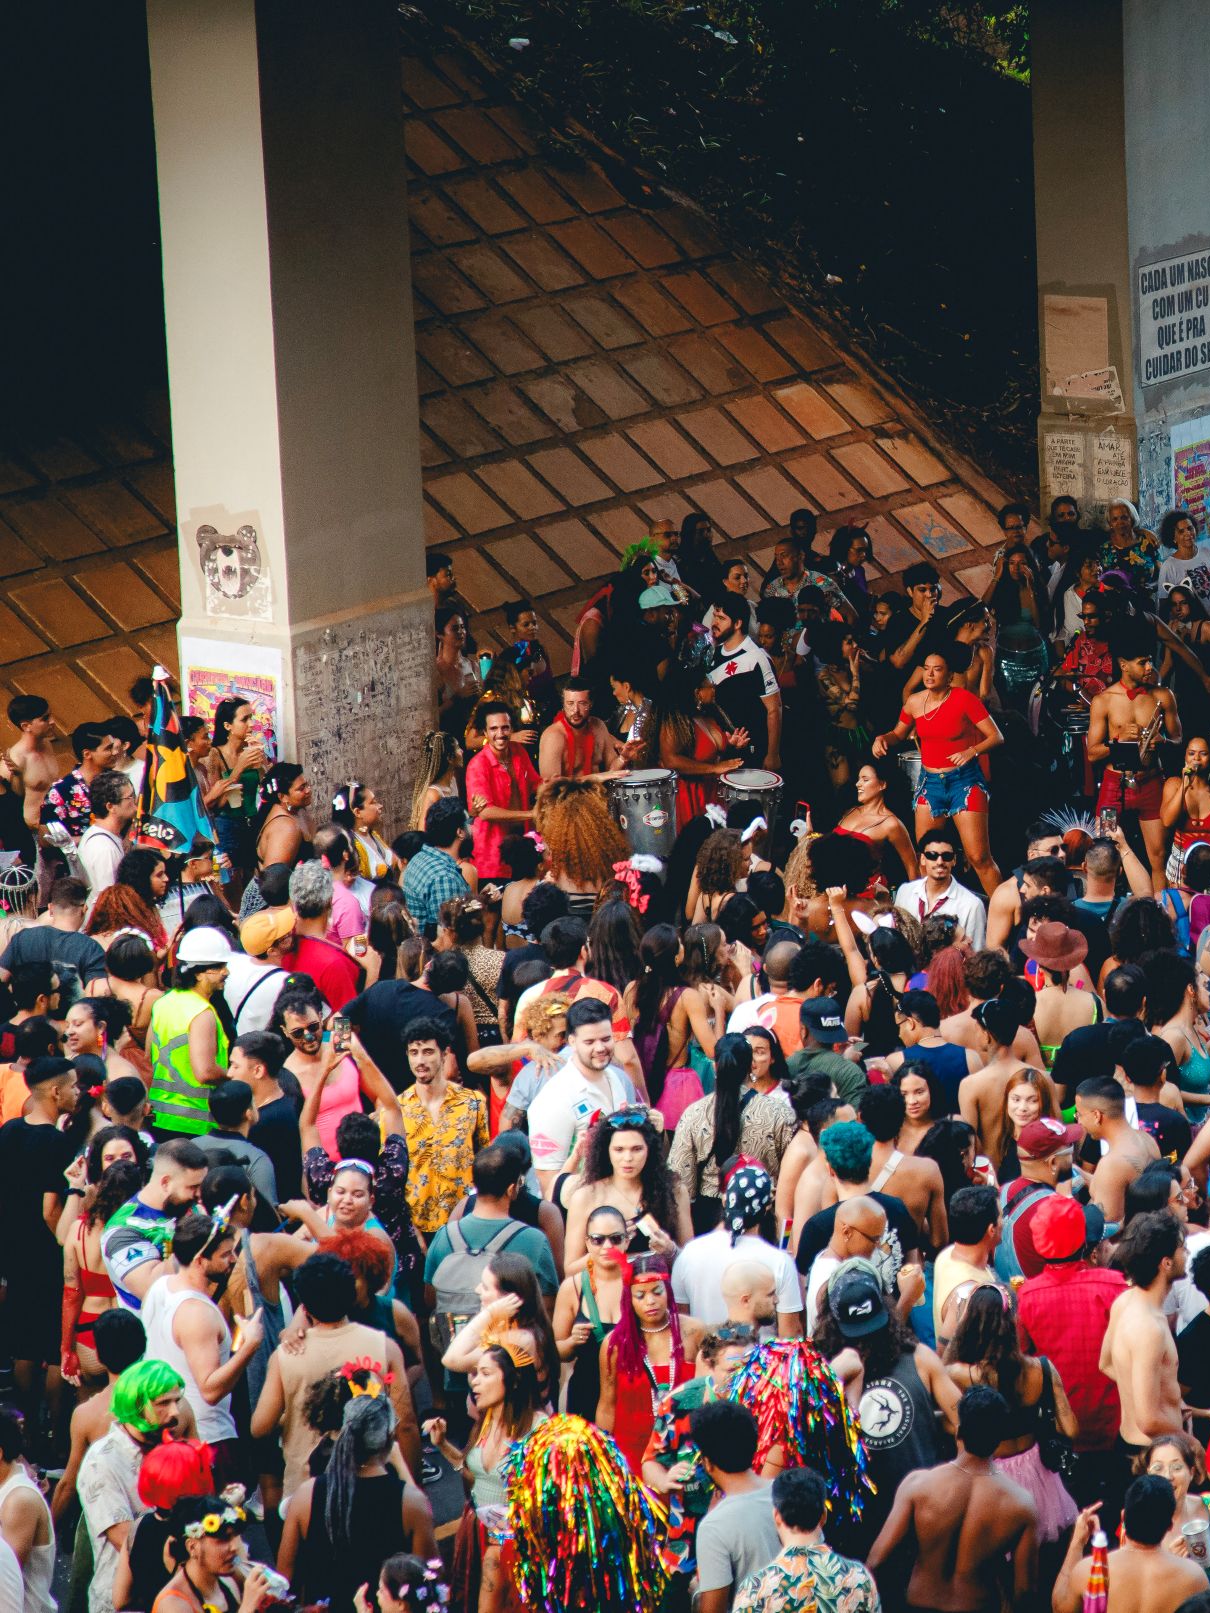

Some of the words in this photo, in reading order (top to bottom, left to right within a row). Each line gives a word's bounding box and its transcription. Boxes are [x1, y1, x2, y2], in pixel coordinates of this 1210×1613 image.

[1141, 267, 1168, 295] CADA
[1169, 262, 1185, 287] UM
[1152, 294, 1175, 321] COM
[1177, 289, 1193, 314] UM
[1195, 285, 1209, 309] CU
[1157, 322, 1176, 350] QUE
[1178, 316, 1184, 343] É
[1186, 315, 1206, 340] PRA
[1145, 350, 1182, 381] CUIDAR
[1184, 345, 1198, 369] DO
[1098, 441, 1121, 451] AMAR
[820, 1016, 841, 1027] VANS
